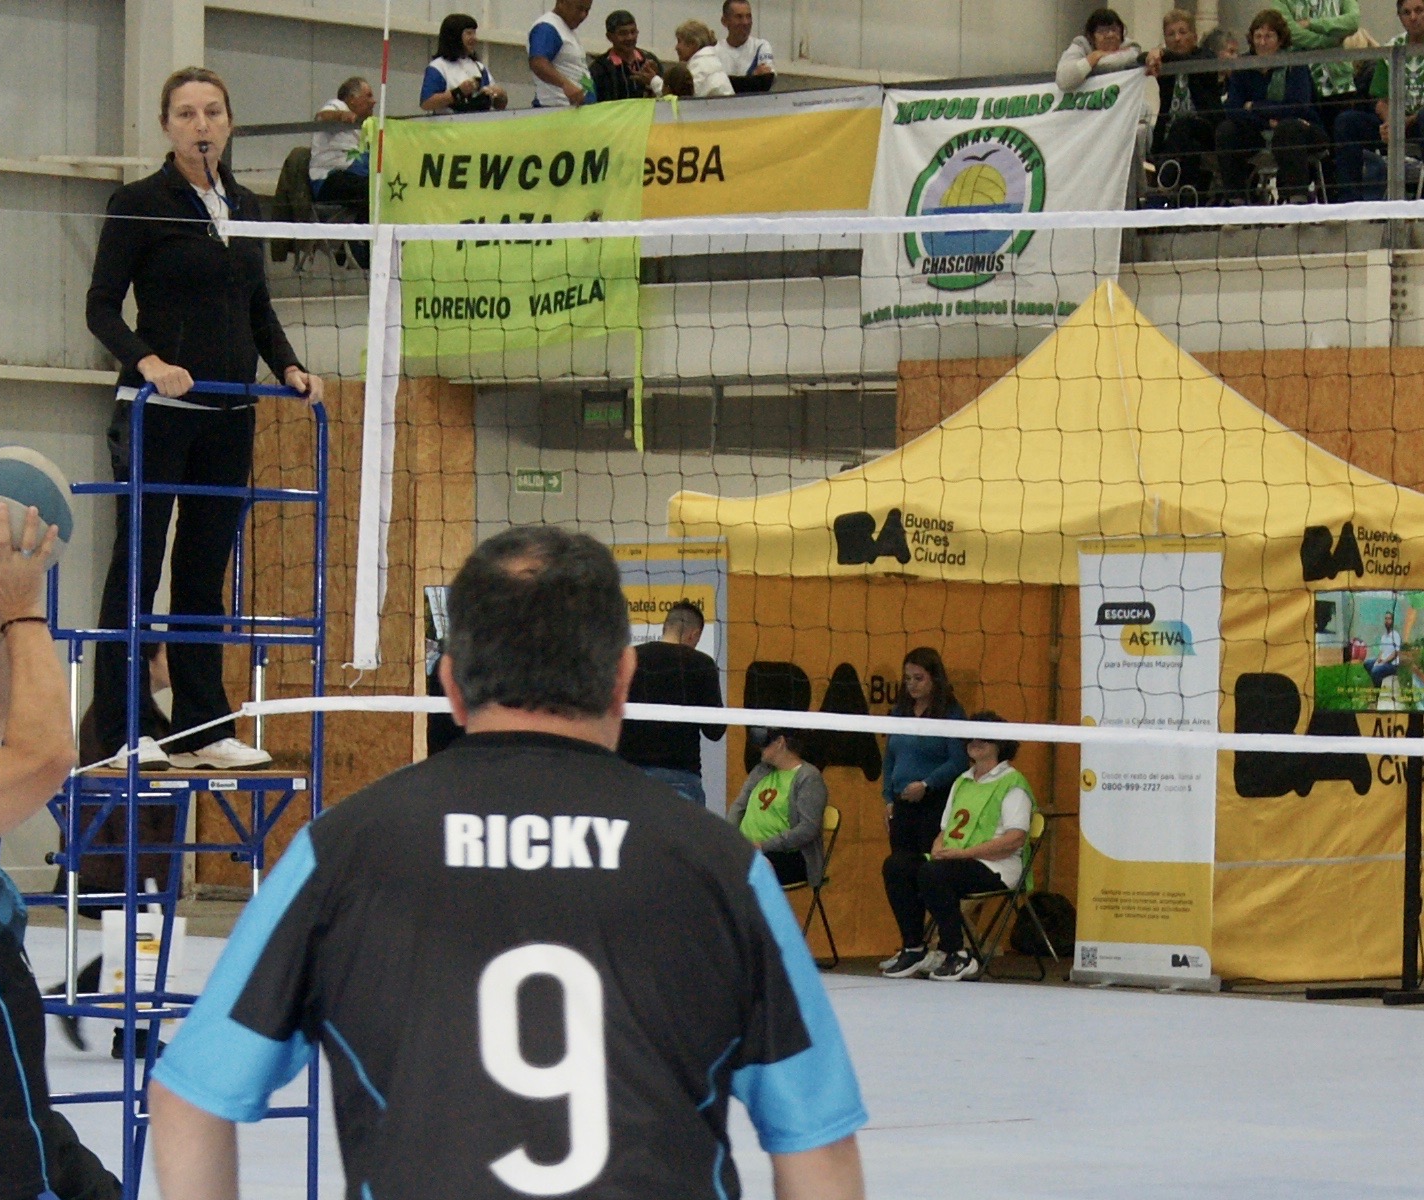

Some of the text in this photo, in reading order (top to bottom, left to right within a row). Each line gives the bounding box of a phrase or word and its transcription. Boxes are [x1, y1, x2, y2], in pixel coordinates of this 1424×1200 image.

[935, 128, 1041, 174] LOMAS ALTAS
[419, 147, 610, 190] NEWCOM
[415, 280, 605, 320] FLORENCIO VARELA
[905, 513, 954, 532] Buenos
[911, 531, 950, 547] Aires
[1357, 526, 1403, 543] Buenos
[914, 547, 966, 565] Ciudad
[1363, 542, 1398, 558] Aires
[1365, 559, 1411, 576] Ciudad
[1104, 609, 1151, 620] ESCUCHA
[1128, 631, 1185, 646] ACTIVA
[758, 788, 777, 810] 9
[949, 808, 970, 840] 2
[444, 813, 629, 870] RICKY
[478, 942, 610, 1197] 9
